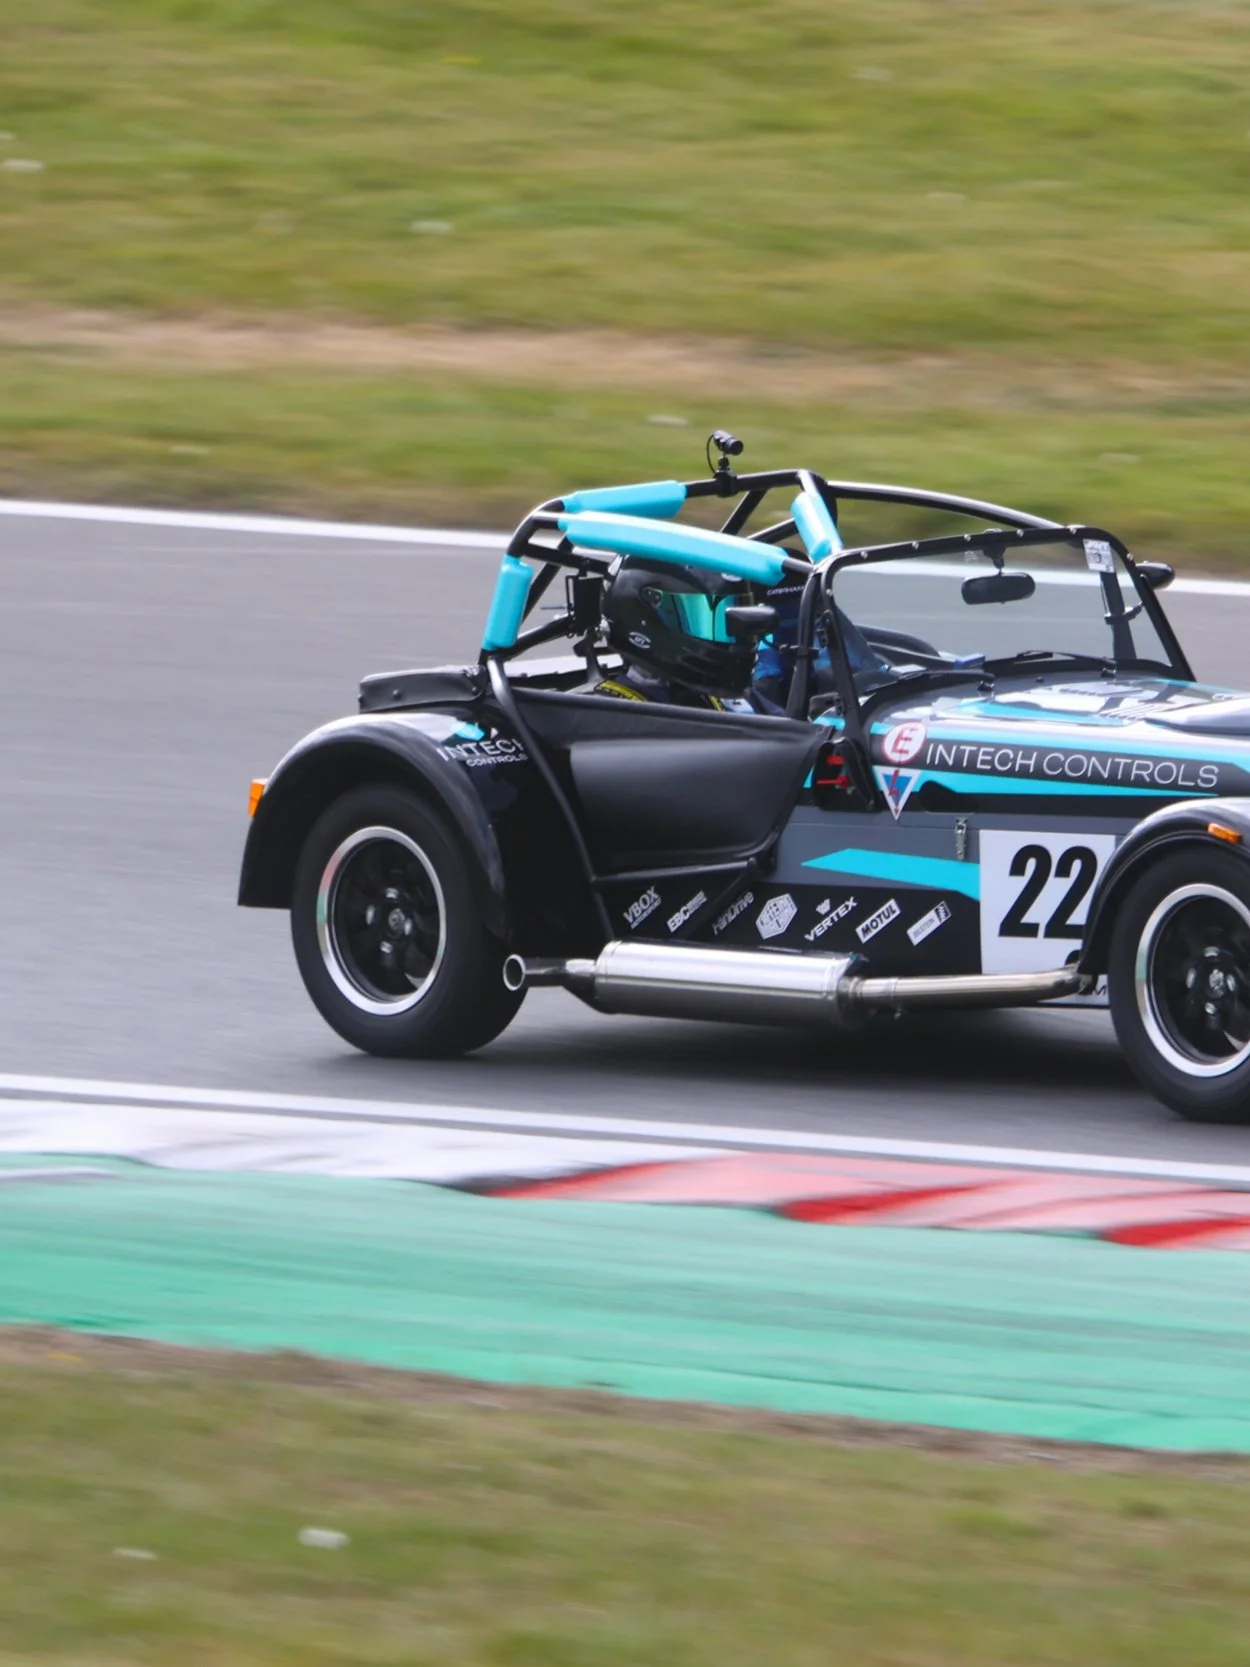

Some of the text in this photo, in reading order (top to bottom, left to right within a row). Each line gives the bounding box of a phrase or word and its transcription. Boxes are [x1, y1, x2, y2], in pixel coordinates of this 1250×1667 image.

[466, 752, 528, 767] CONTROLS
[926, 743, 1220, 789] INTECH CONTROLS
[622, 886, 660, 924] VBOX
[998, 843, 1098, 940] 22
[666, 904, 691, 933] EBC
[804, 896, 858, 942] VERTEX
[861, 903, 897, 940] MOTUL
